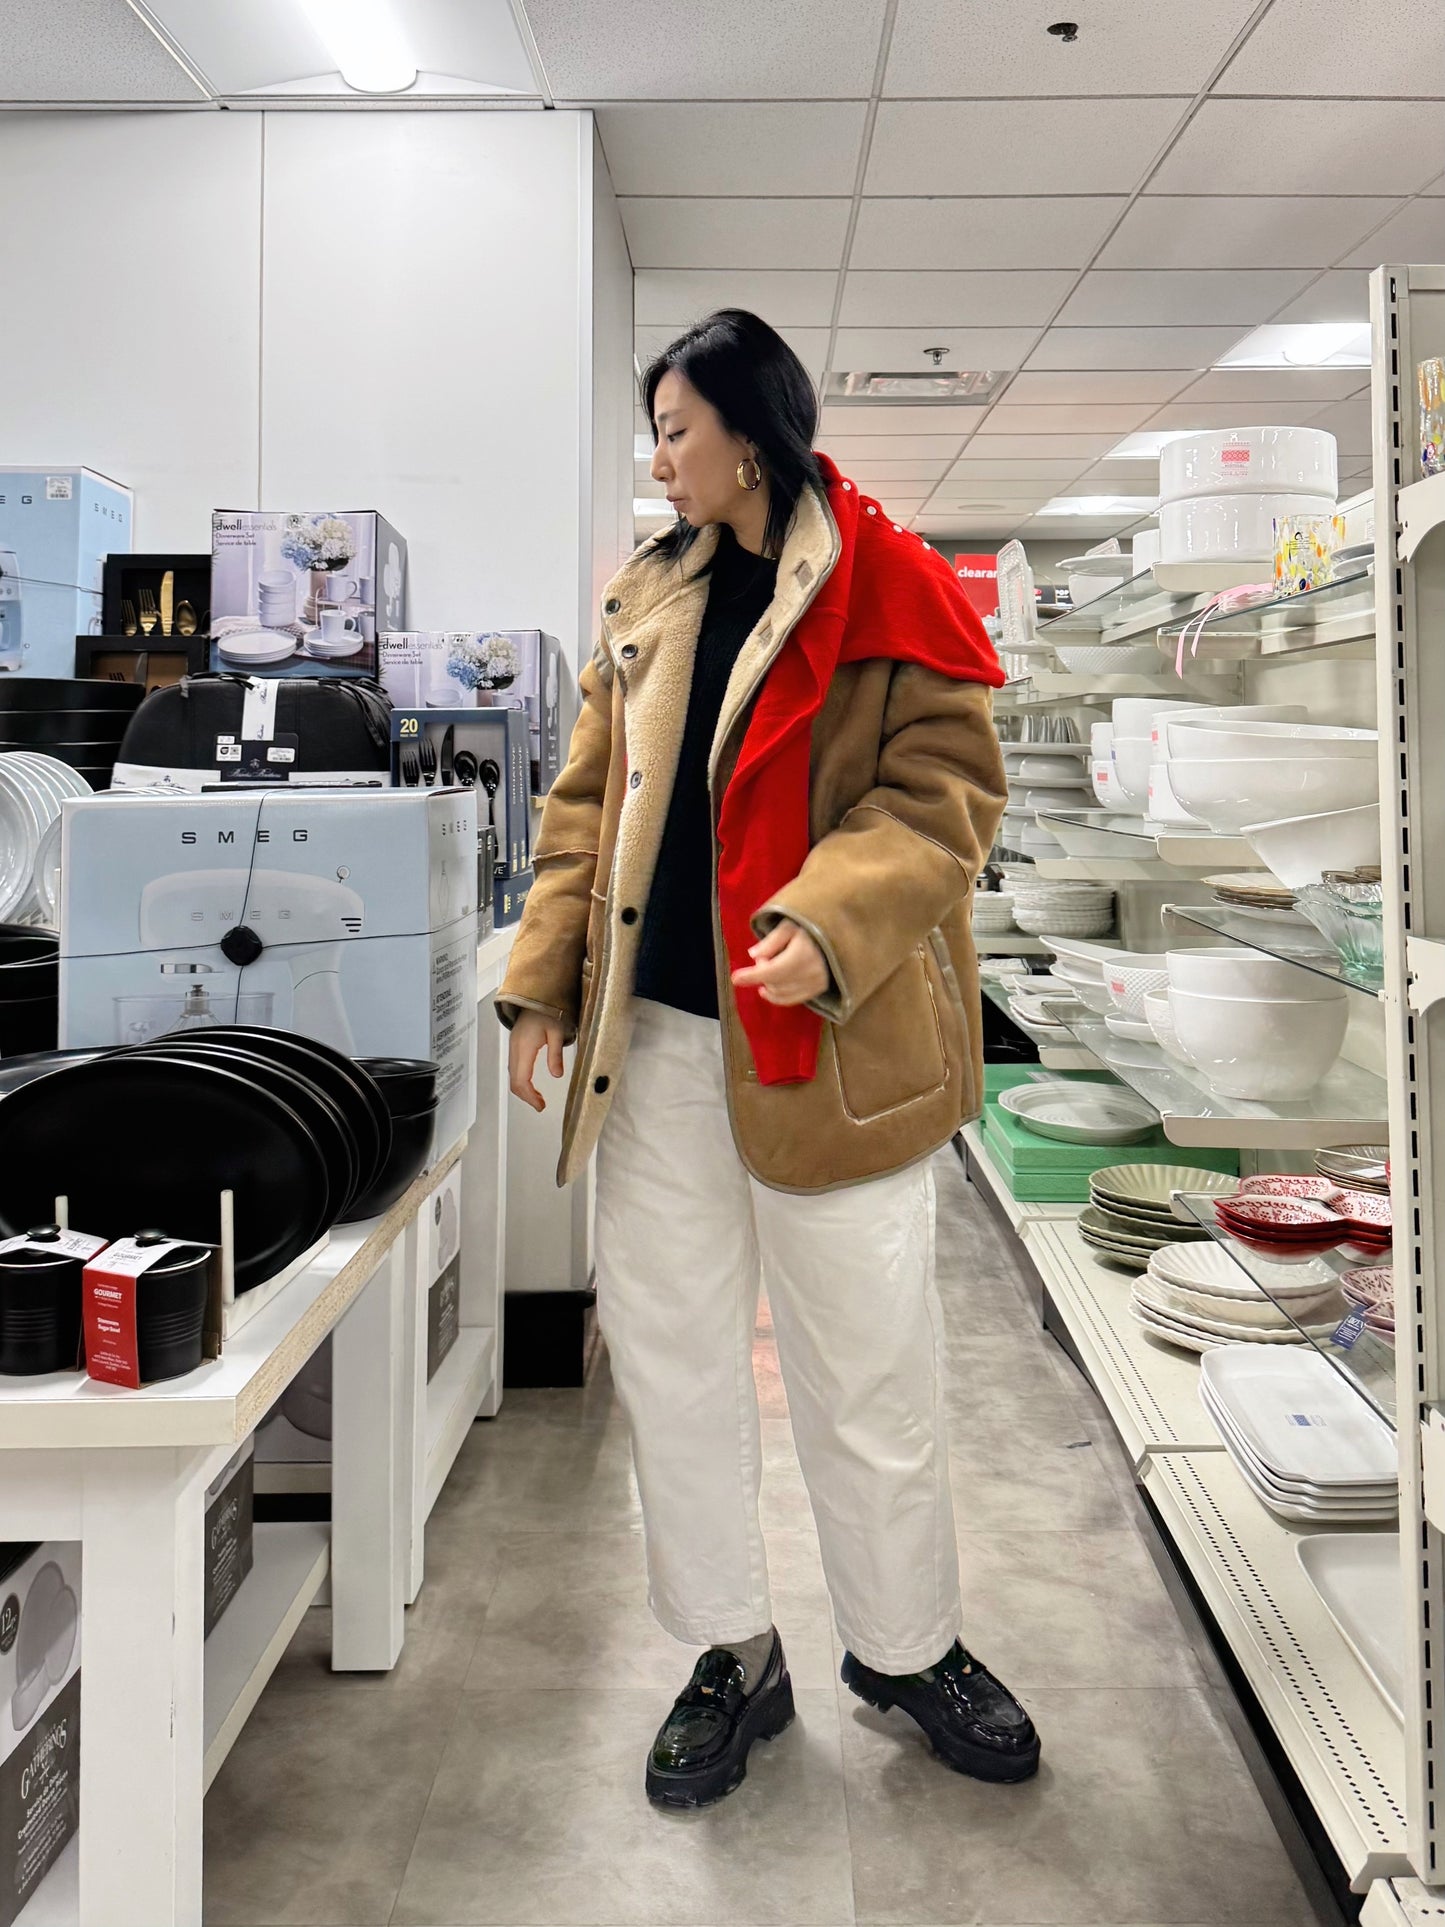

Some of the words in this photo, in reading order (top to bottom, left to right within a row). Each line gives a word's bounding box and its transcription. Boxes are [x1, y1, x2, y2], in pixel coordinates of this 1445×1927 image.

[400, 718, 418, 733] 20
[181, 829, 308, 844] SMEG
[191, 910, 290, 921] SMEG
[94, 1288, 122, 1299] GOURMET
